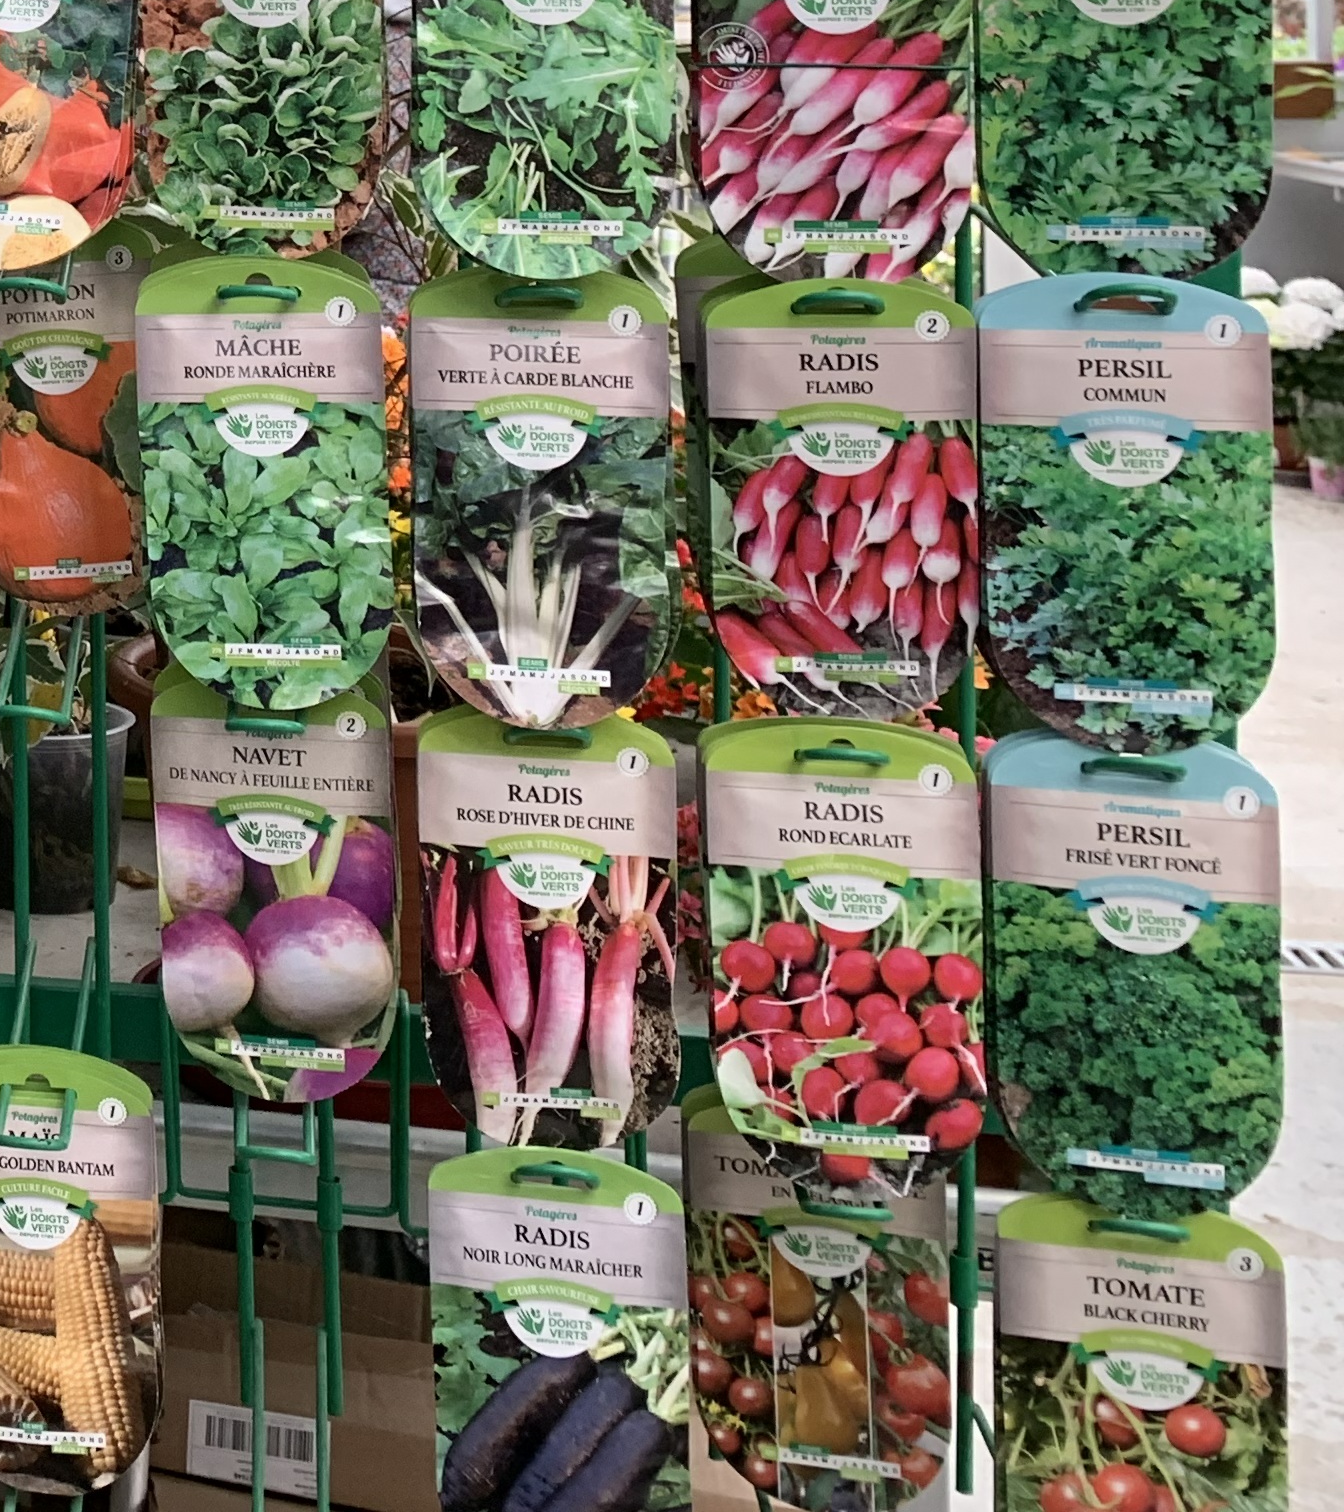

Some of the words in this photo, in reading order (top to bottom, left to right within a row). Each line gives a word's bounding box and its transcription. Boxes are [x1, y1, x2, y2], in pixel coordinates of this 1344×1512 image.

[3, 307, 94, 325] POTIMARRON
[216, 335, 301, 356] MÂCHE
[489, 341, 581, 364] POIRÉE
[184, 366, 233, 378] RONDE
[232, 362, 335, 378] MARAÎCHÈRE
[799, 354, 878, 371] RADIS
[1079, 359, 1171, 378] PERSIL
[807, 381, 873, 394] FLAMBO
[1084, 388, 1165, 402] COMMUN
[256, 420, 297, 429] DOIGTS
[257, 430, 293, 439] VERTS
[233, 746, 306, 766] NAVET
[508, 784, 582, 805] RADIS
[805, 802, 883, 823] RADIS
[1097, 823, 1190, 847] PERSIL
[0, 1156, 54, 1172] GOLDEN
[58, 1160, 114, 1176] BANTAM
[515, 1224, 589, 1249] RADIS
[463, 1246, 500, 1264] NOIR
[505, 1252, 546, 1269] LONG
[550, 1257, 642, 1278] MARAÎCHER
[1240, 1257, 1251, 1271] 3
[1087, 1277, 1203, 1306] TOMATE
[1084, 1304, 1137, 1322] BLACK
[1141, 1311, 1206, 1332] CHERRY
